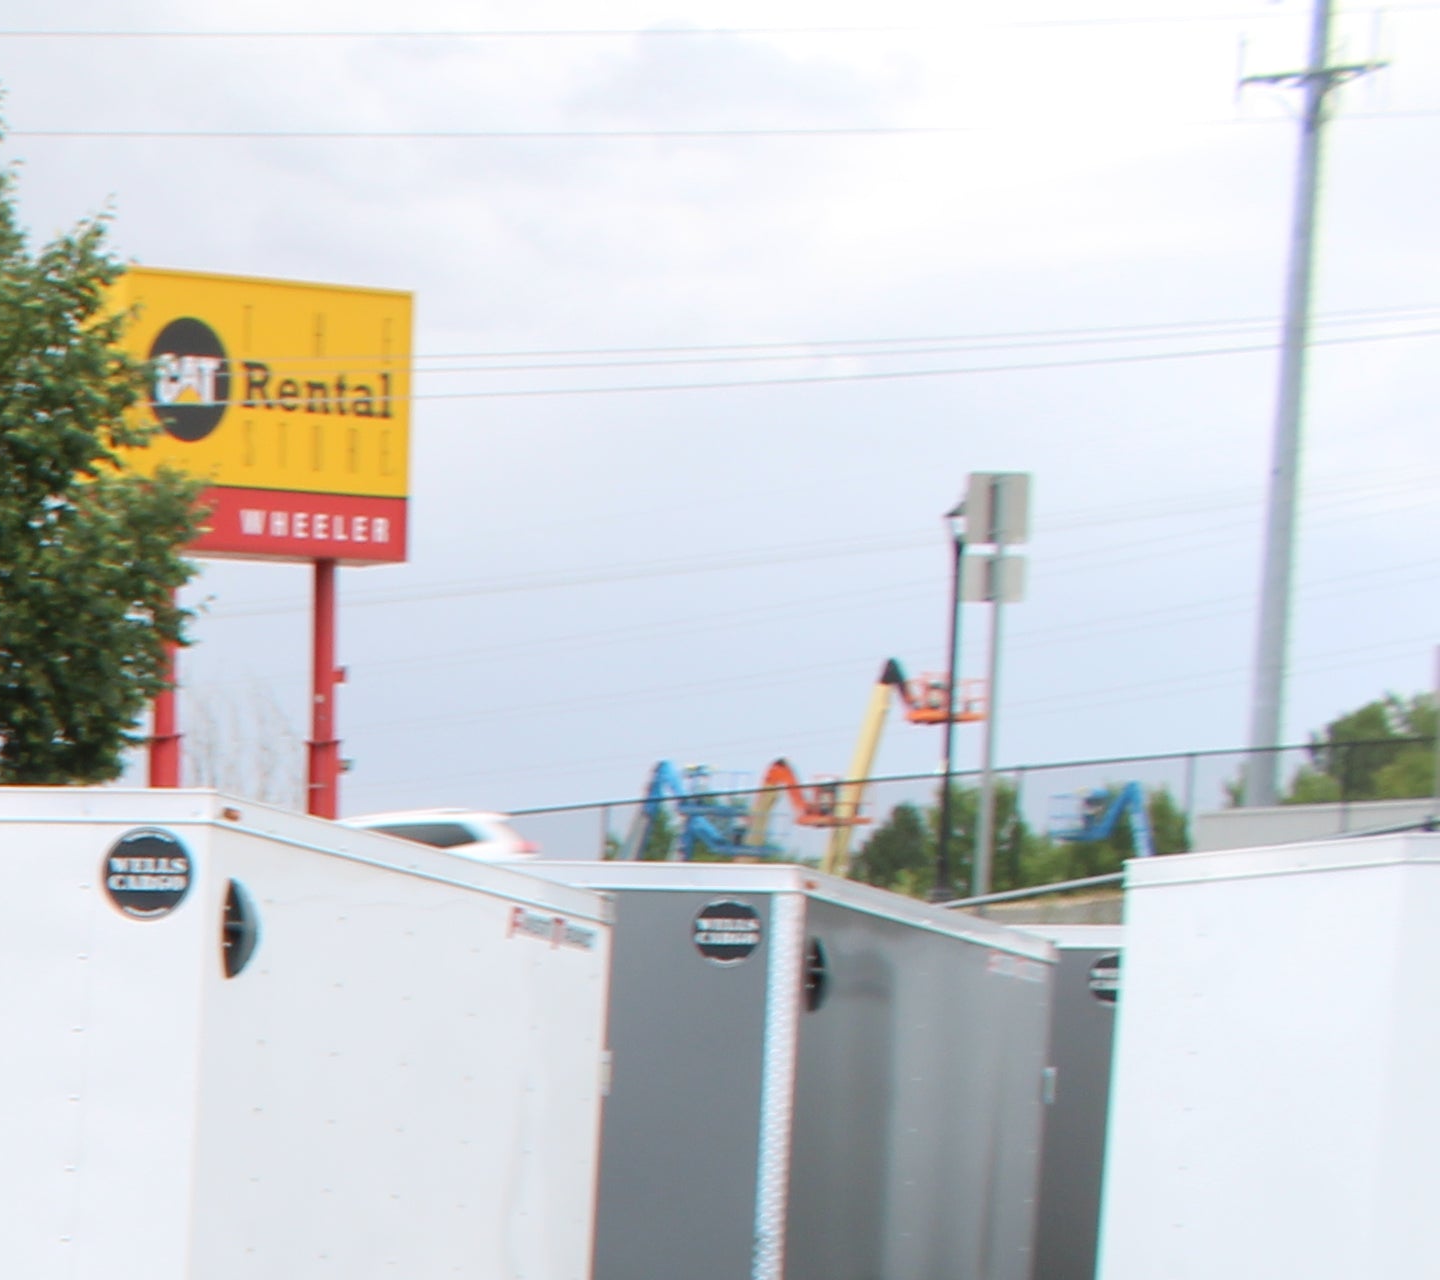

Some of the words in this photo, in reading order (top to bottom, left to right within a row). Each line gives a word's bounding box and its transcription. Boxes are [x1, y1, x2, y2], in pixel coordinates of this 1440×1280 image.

[153, 352, 223, 405] CAT
[241, 361, 392, 419] Rental
[239, 508, 391, 543] WHEELER
[109, 857, 188, 873] WELLS
